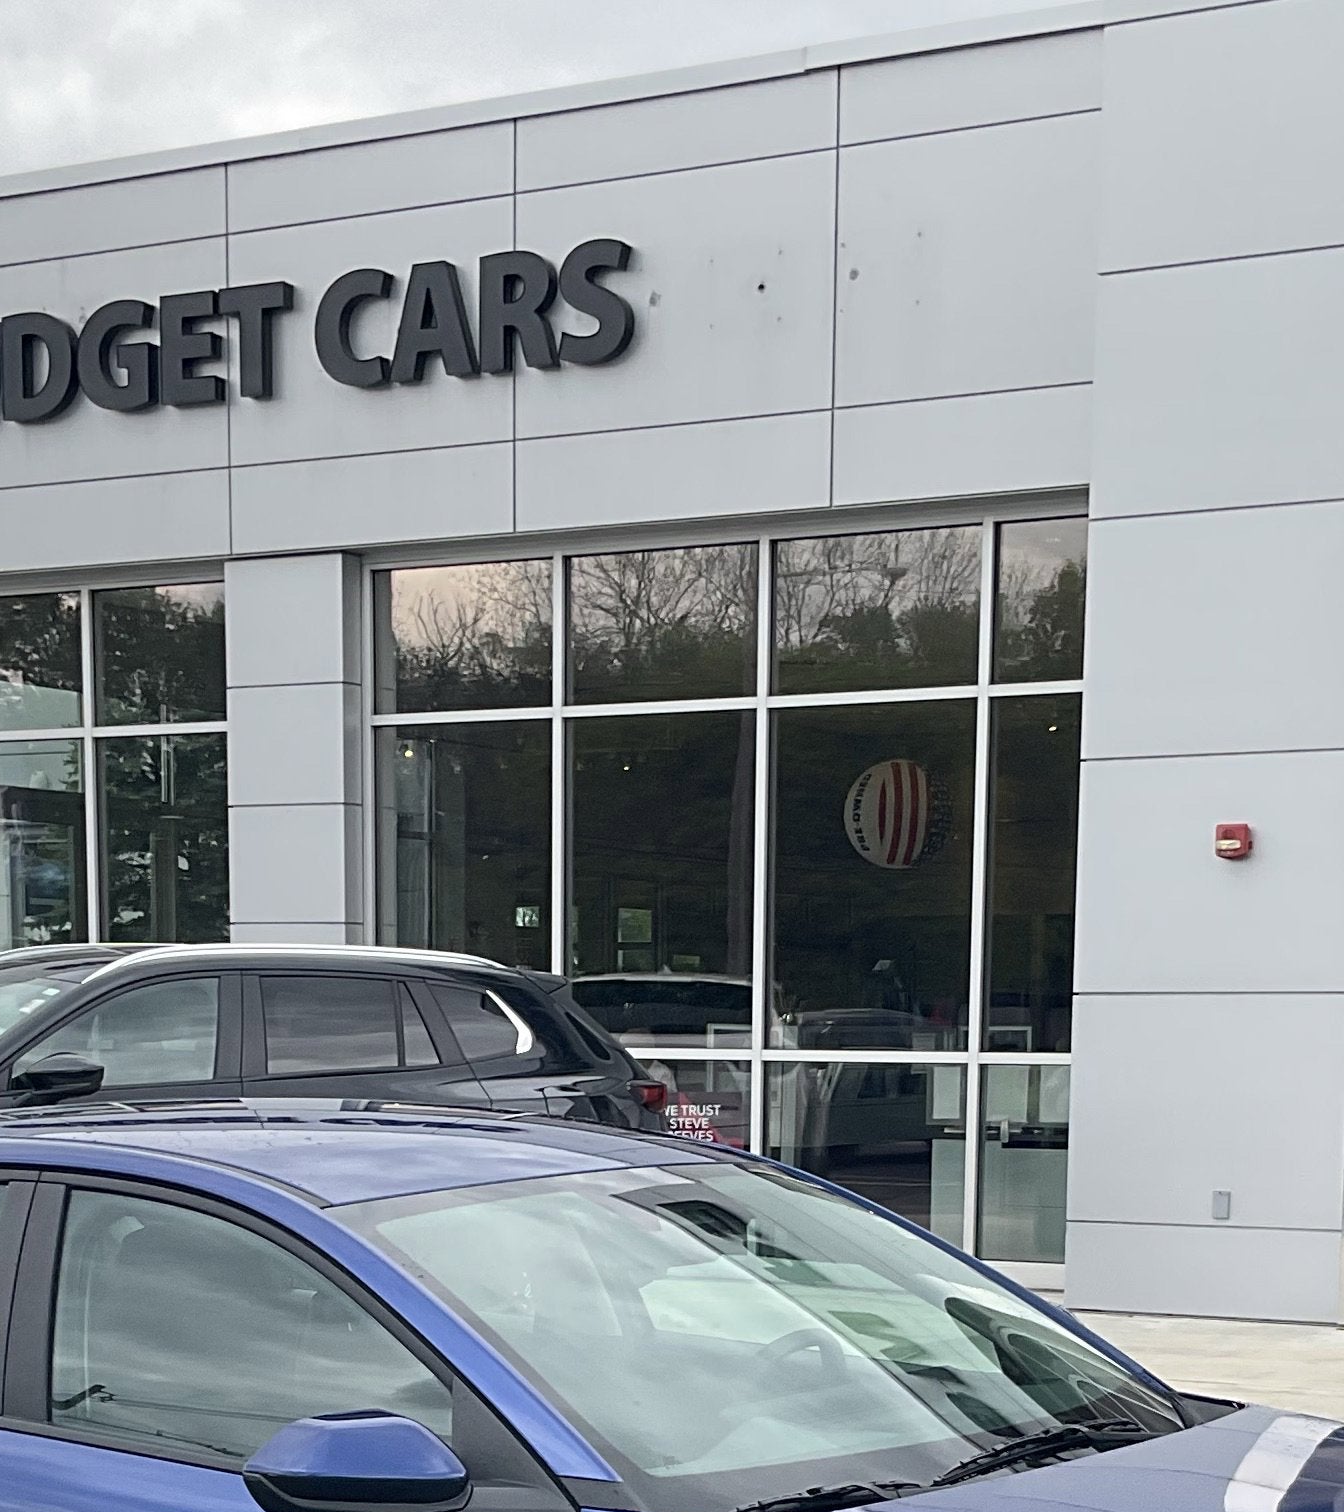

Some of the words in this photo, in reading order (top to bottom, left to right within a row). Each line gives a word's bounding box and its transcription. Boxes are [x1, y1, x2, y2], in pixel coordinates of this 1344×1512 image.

[315, 238, 635, 388] CARS
[681, 1104, 721, 1116] TRUST
[669, 1117, 709, 1129] STEVE
